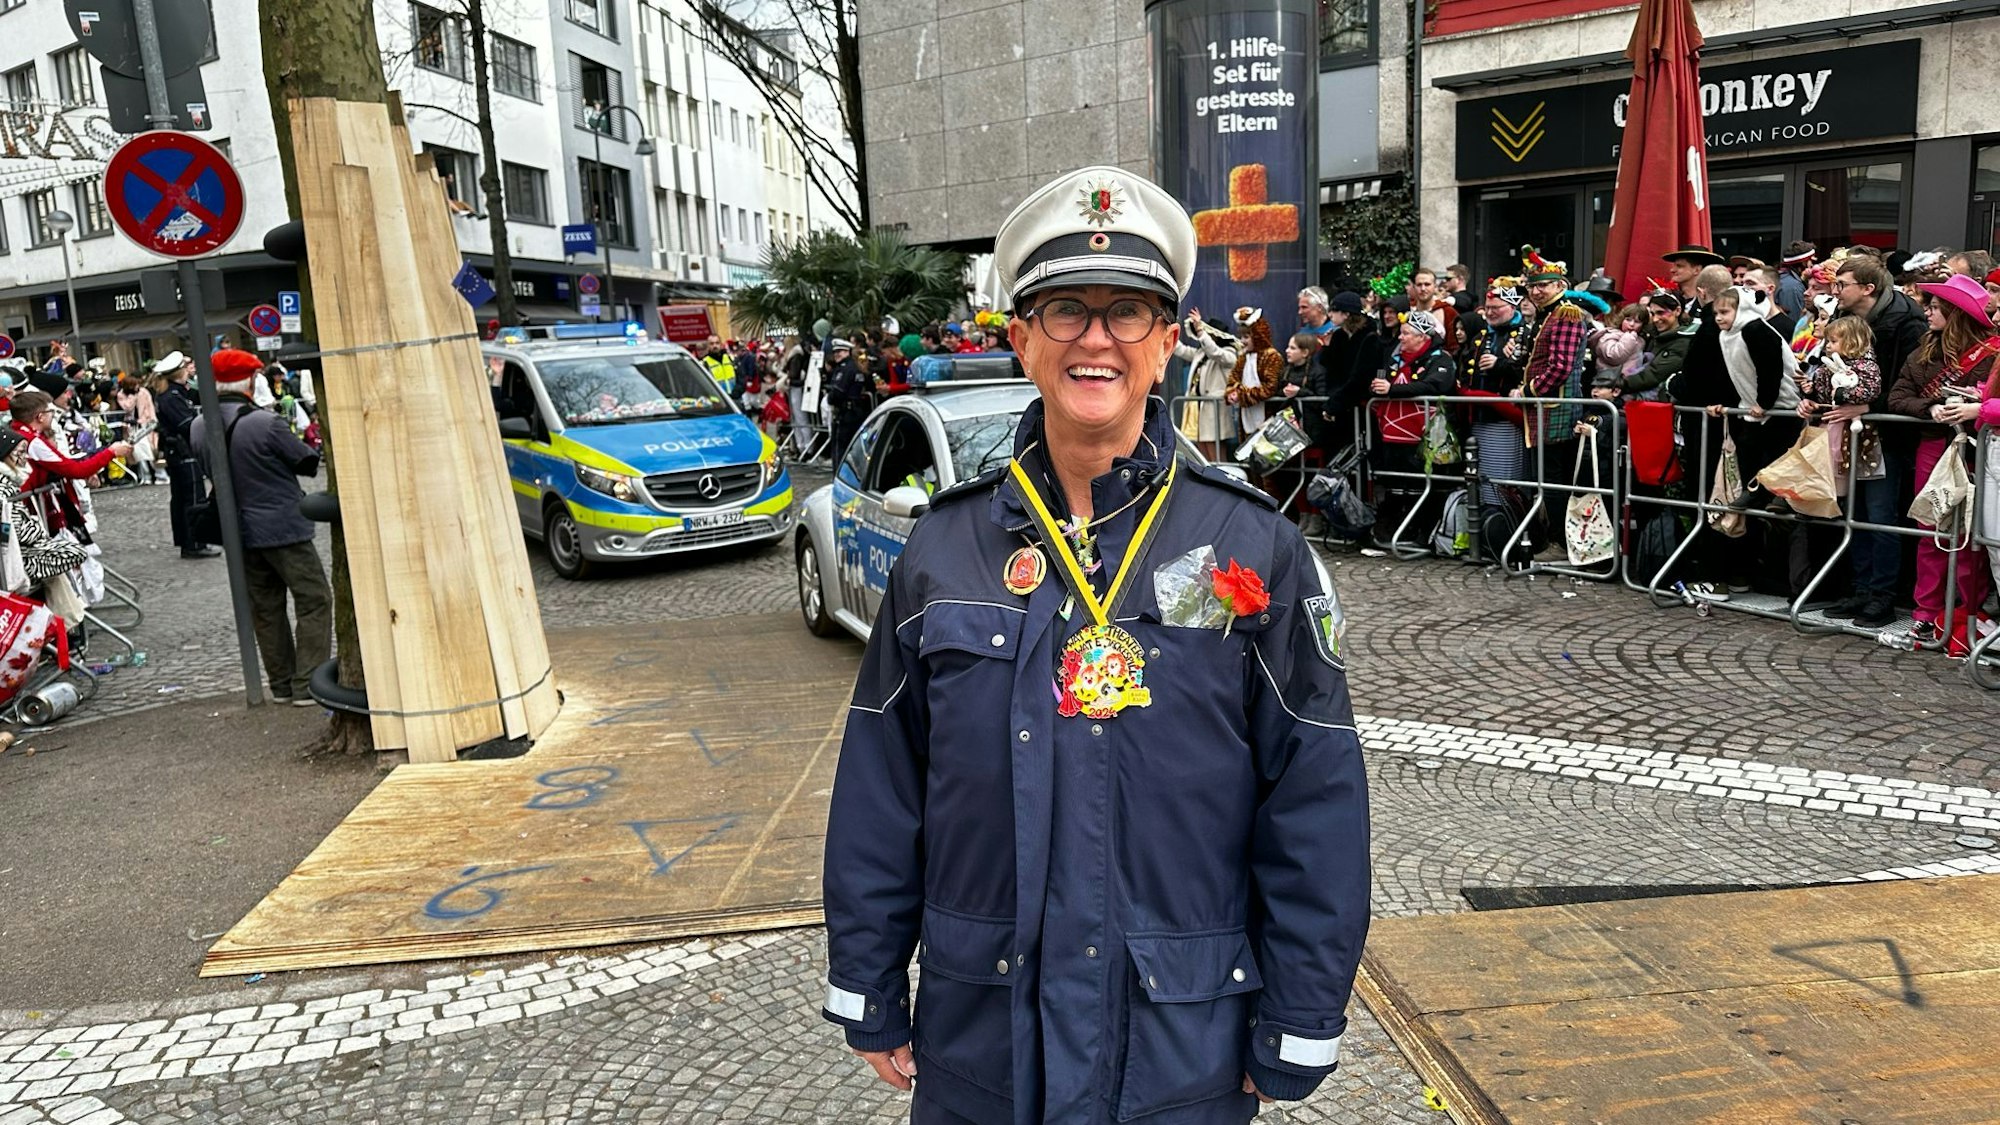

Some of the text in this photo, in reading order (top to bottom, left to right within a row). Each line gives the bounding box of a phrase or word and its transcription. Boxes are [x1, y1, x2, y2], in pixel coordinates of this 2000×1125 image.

[1207, 37, 1286, 60] 1. Hilfe-
[1213, 62, 1281, 85] Set für
[1196, 88, 1295, 117] gestresste
[1217, 113, 1278, 133] Eltern
[1771, 121, 1830, 141] FOOD
[114, 292, 138, 312] ZEISS
[643, 436, 735, 456] POLIZEI
[690, 511, 743, 529] NRW 4 2327
[869, 544, 898, 577] POLI
[1106, 624, 1145, 658] THEATER
[1089, 706, 1117, 718] 2024
